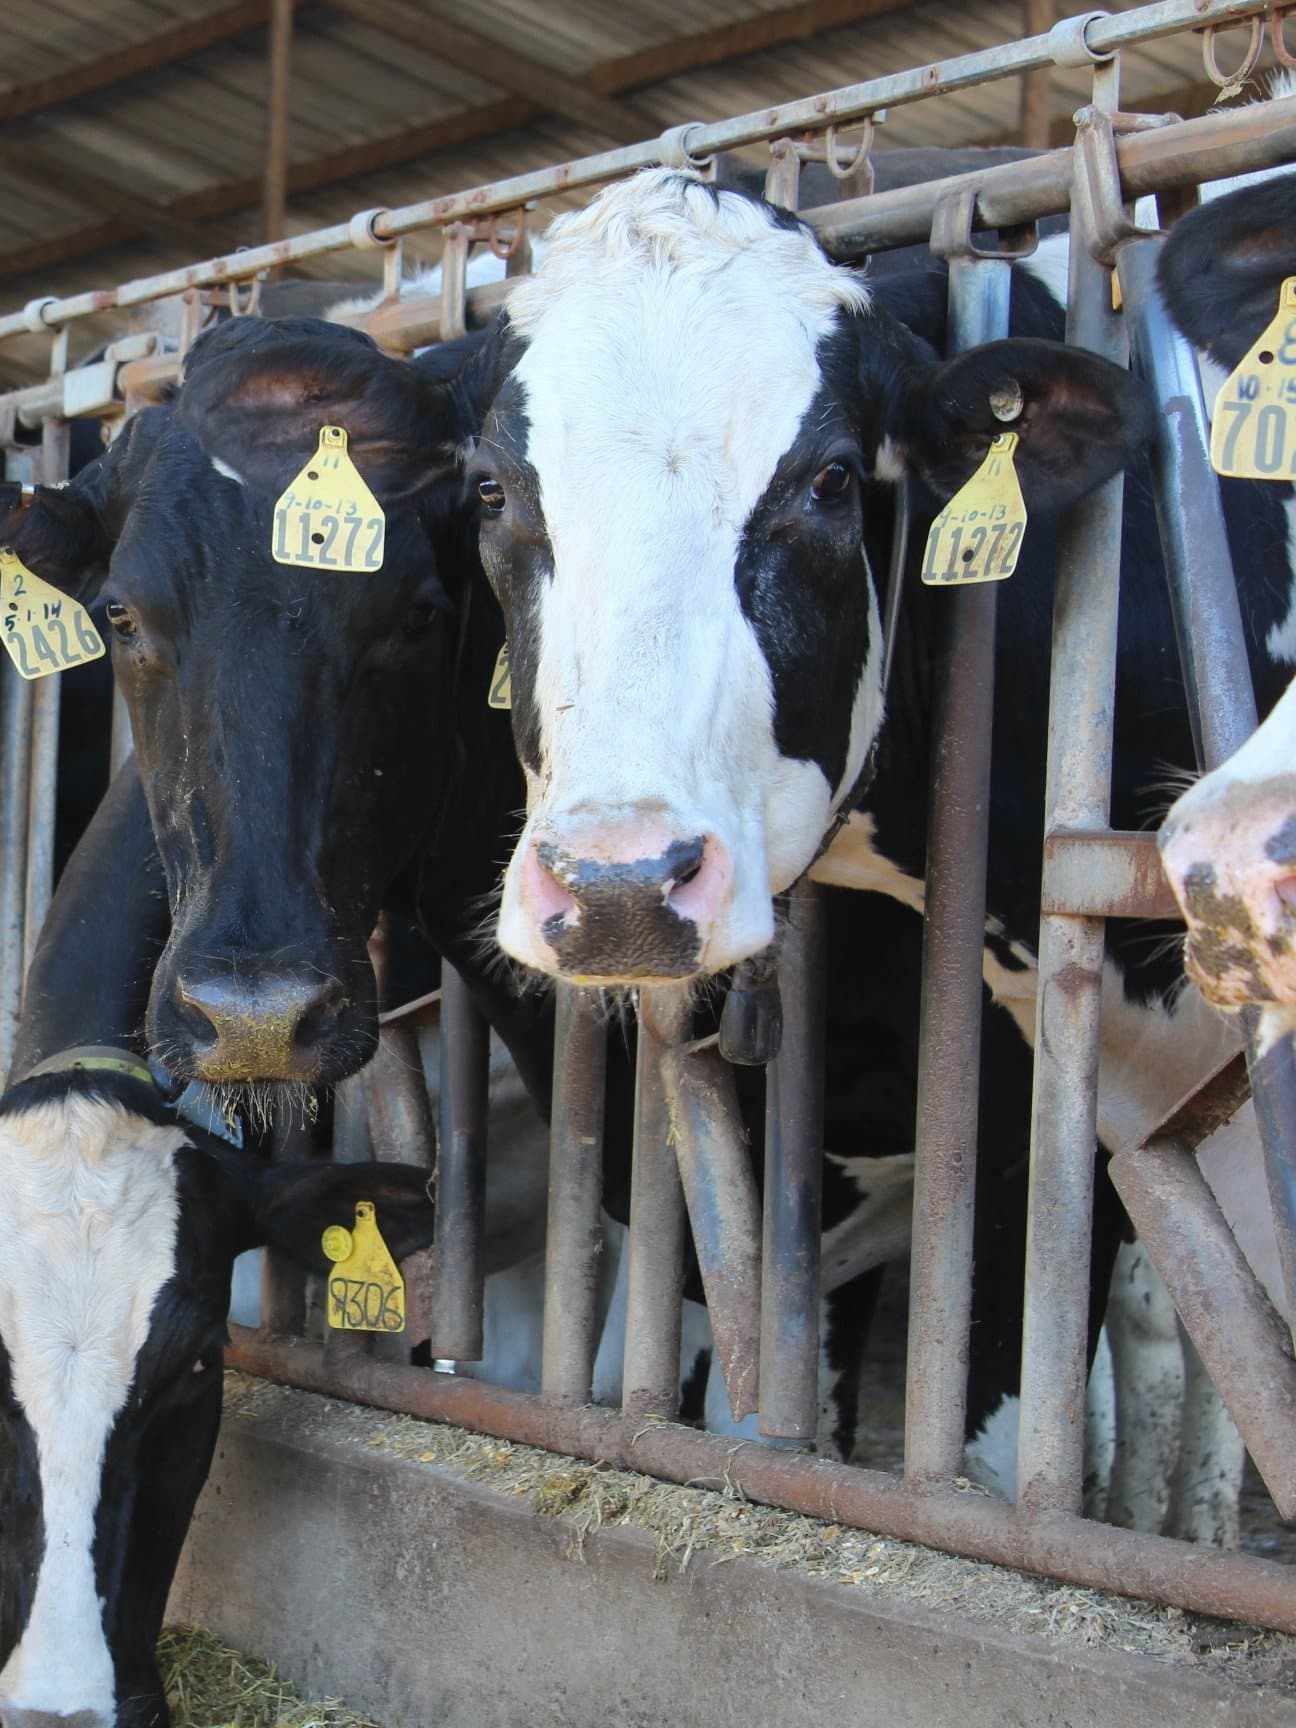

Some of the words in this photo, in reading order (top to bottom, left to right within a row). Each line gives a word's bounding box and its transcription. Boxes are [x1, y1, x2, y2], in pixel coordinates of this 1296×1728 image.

[1222, 401, 1296, 474] 70
[275, 508, 384, 568] 11272
[923, 521, 1024, 582] 11272
[14, 574, 26, 597] 2
[7, 611, 102, 676] 2426
[330, 1277, 403, 1331] 9306
